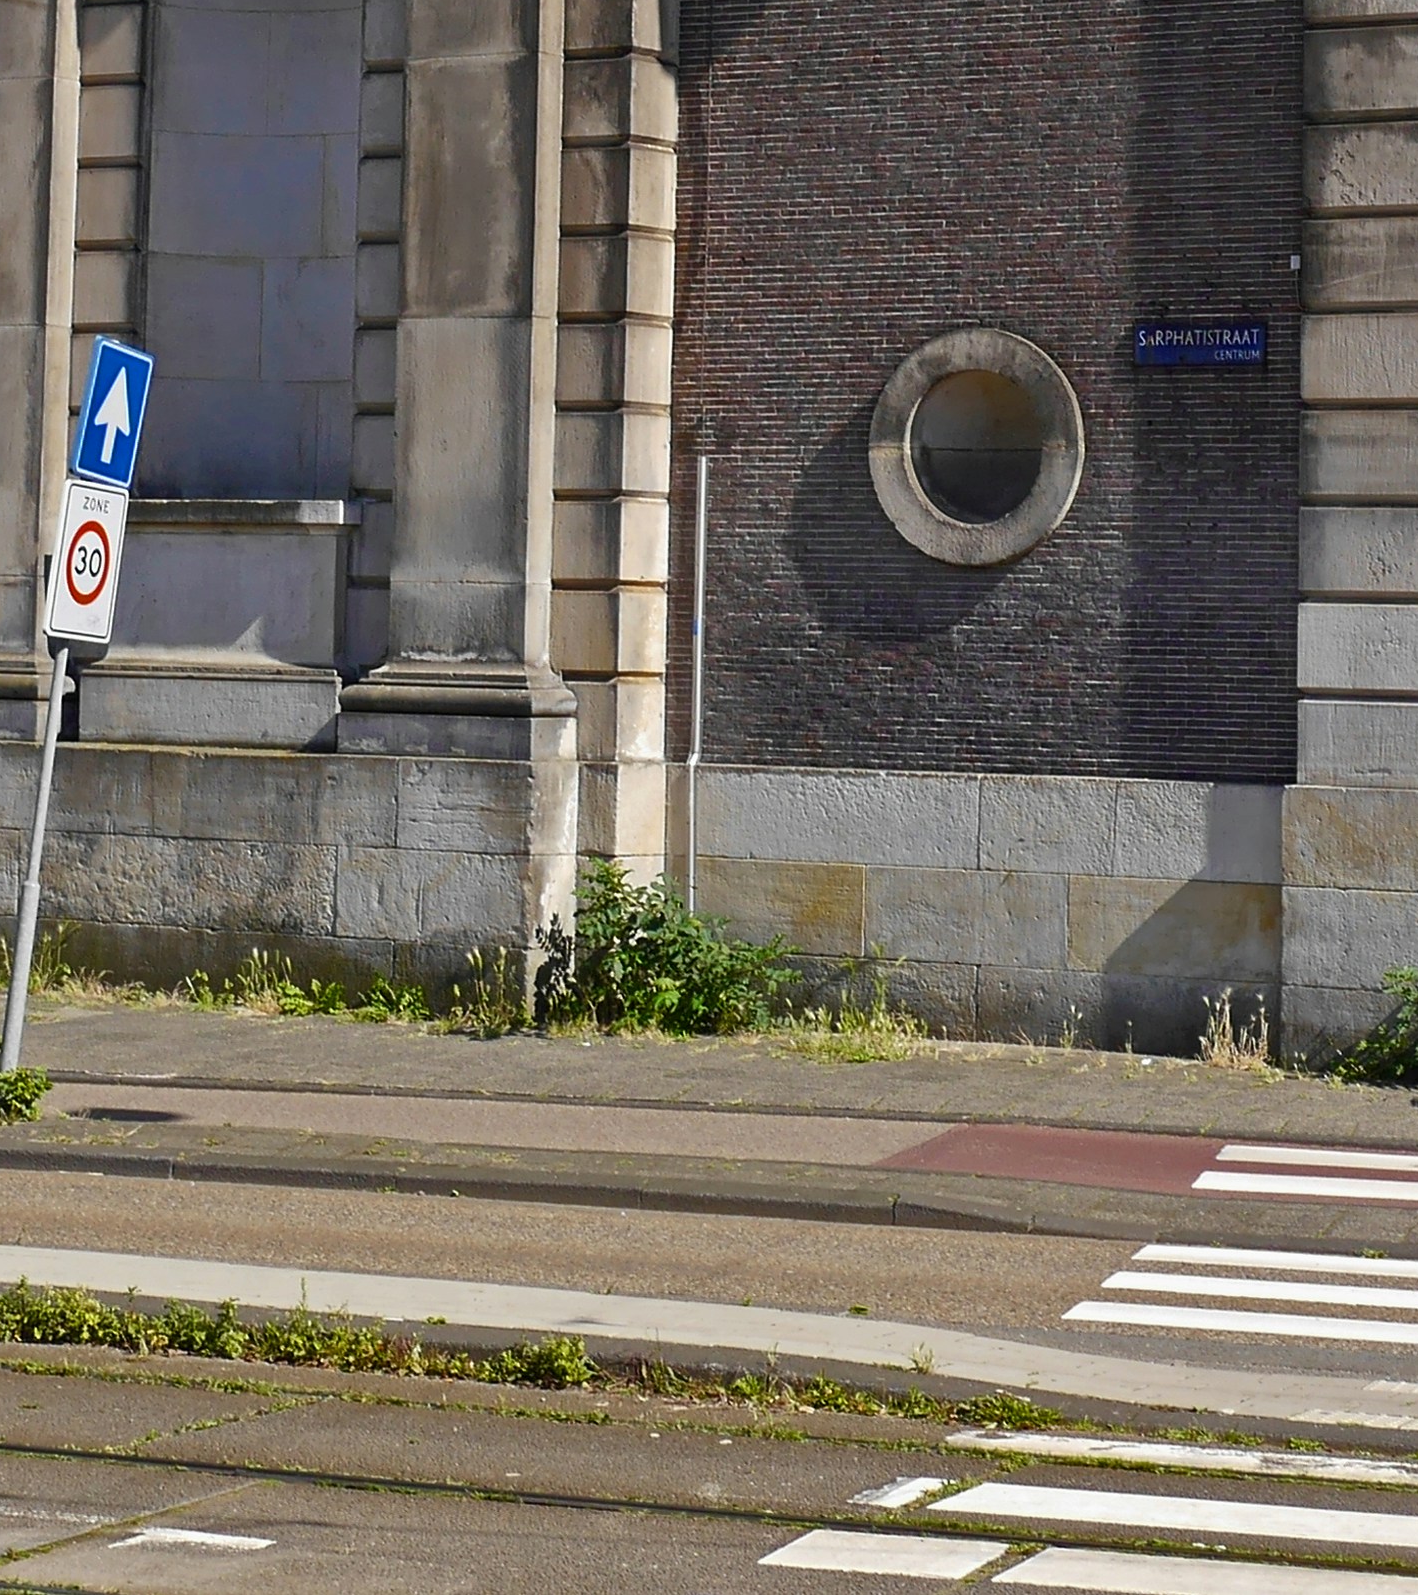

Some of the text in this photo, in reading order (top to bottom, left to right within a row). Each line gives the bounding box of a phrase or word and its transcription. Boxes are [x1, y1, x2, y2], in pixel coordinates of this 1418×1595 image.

[1138, 328, 1261, 347] SARPHATISTRAAT
[1213, 349, 1261, 361] CENTRUM
[82, 495, 111, 514] ZONE
[74, 545, 103, 578] 30
